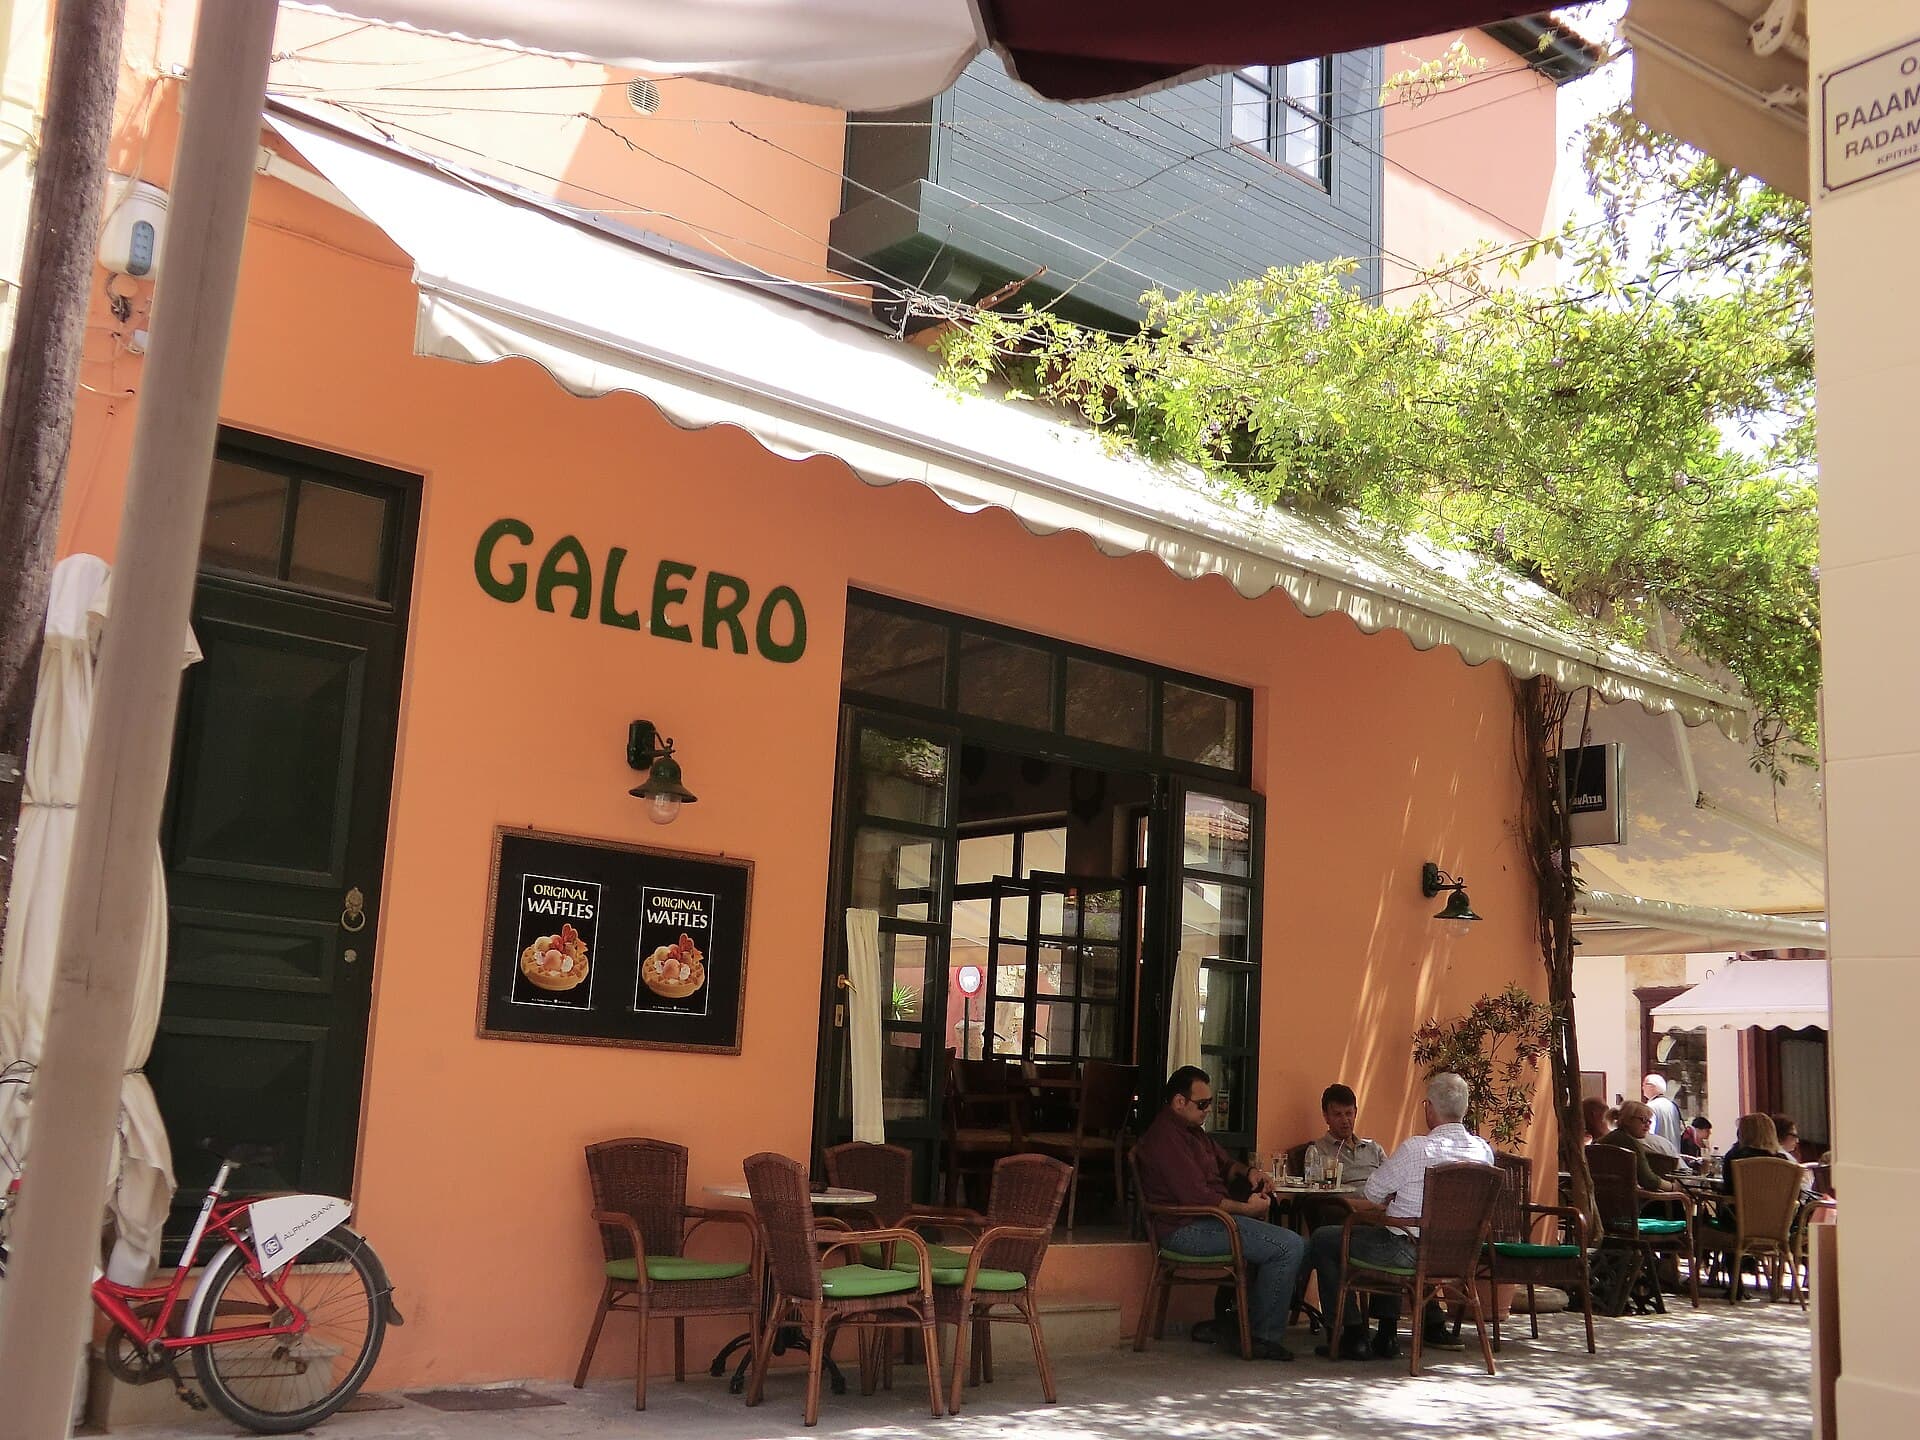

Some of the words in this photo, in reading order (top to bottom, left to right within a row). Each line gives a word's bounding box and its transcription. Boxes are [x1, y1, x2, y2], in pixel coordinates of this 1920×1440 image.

[1901, 56, 1920, 75] Ο
[1845, 117, 1920, 159] RADAM
[473, 518, 807, 664] GALERO
[533, 884, 589, 902] ORIGINAL
[527, 897, 594, 920] WAFFLES
[652, 896, 703, 912] ORIGINAL
[646, 909, 708, 929] WAFFLES
[284, 1219, 311, 1240] ALPHA
[311, 1201, 336, 1221] BANK
